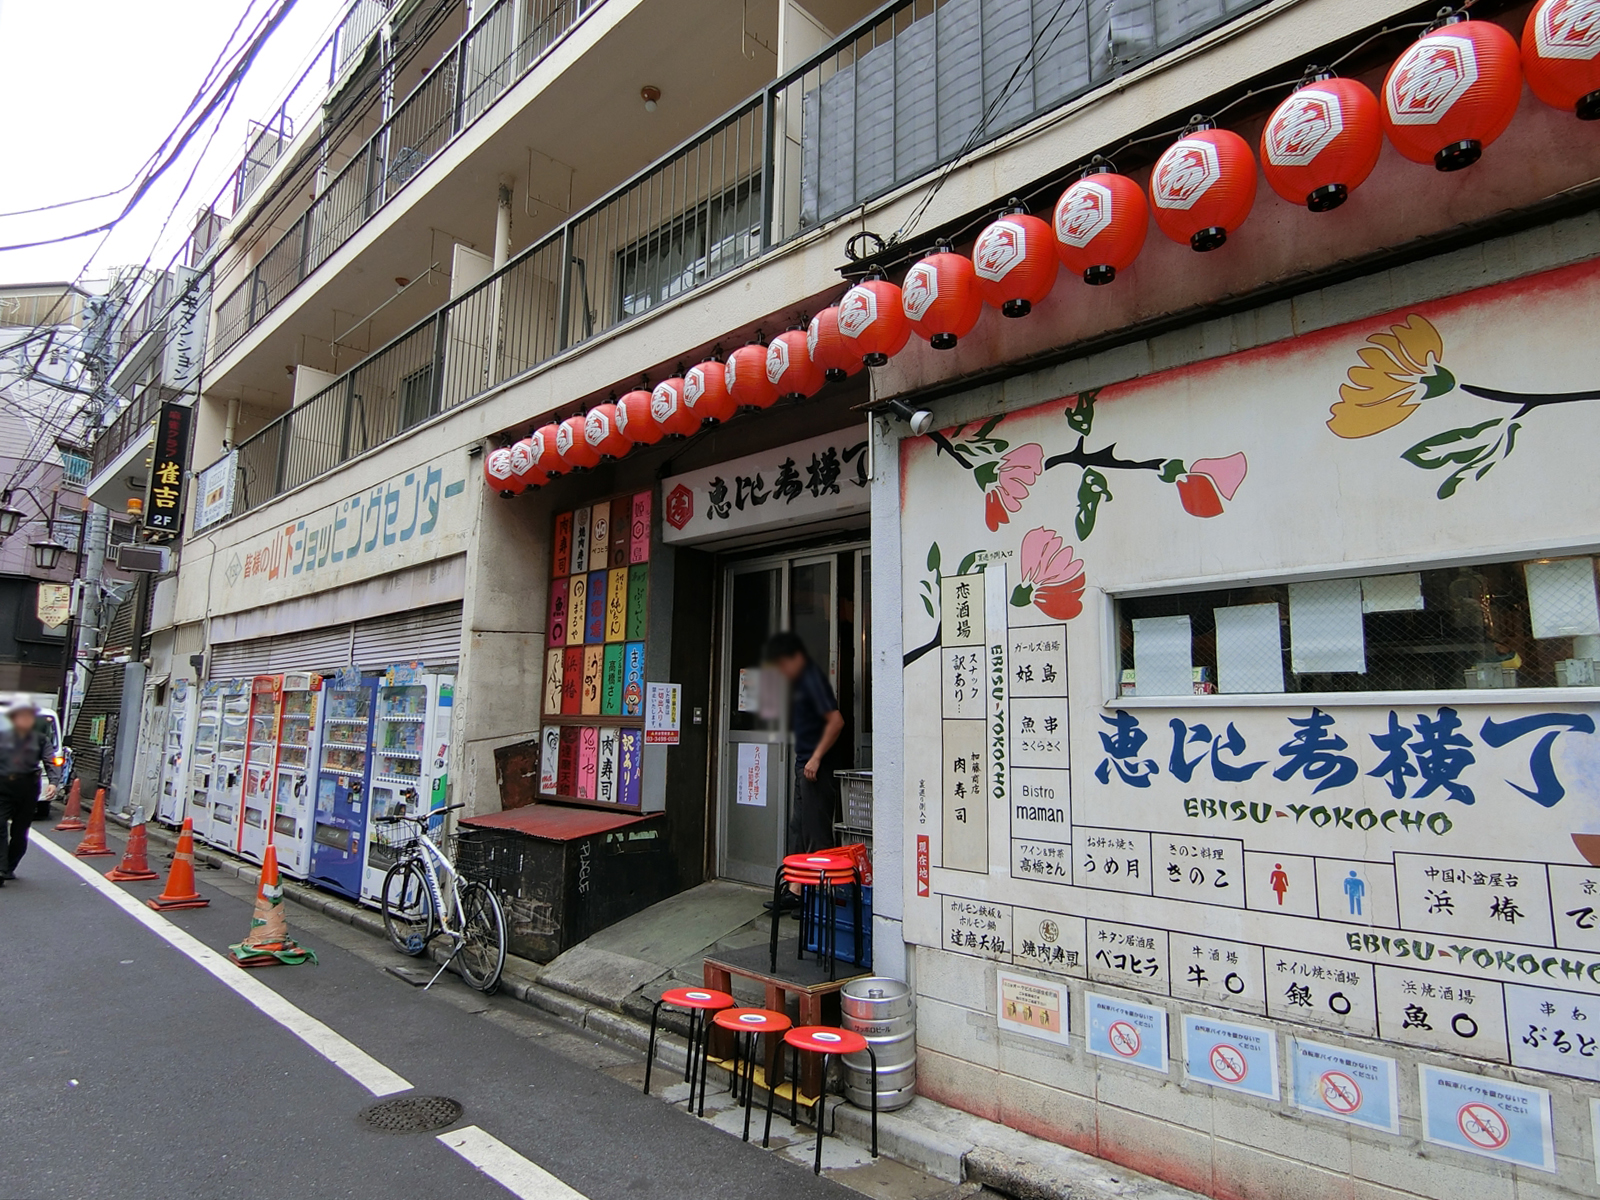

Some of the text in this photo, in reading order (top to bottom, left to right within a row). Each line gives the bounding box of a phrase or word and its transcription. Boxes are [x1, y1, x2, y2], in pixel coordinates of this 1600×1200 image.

[153, 461, 180, 508] 雀吉
[706, 440, 869, 520] 恵比寿横丁
[153, 514, 172, 526] 2F
[557, 517, 569, 573] 肉寿司
[576, 526, 586, 571] 焼肉寿司
[955, 581, 971, 639] 恋酒場
[1013, 640, 1060, 653] ガールズ酒場
[969, 653, 979, 699] スナック
[1016, 663, 1058, 684] 姫島
[991, 644, 1006, 799] EBISU-YOKOCHO
[1021, 716, 1058, 734] 魚串
[1022, 740, 1061, 752] さくらさく
[1094, 706, 1596, 808] 恵比寿横丁
[600, 735, 614, 801] 肉寿司
[970, 751, 981, 795] 加藤商店
[953, 757, 968, 824] 肉寿司
[1022, 785, 1055, 800] Bistro
[1016, 805, 1064, 823] maman
[1183, 797, 1453, 837] EBISU-YOKOCHO
[1086, 836, 1136, 851] お好み焼き
[1168, 843, 1226, 860] きのこ料理
[917, 841, 929, 880] 現在地
[1083, 854, 1140, 878] うめ月
[1166, 862, 1229, 888] きのこ
[951, 901, 1002, 919] ホルモン鉄板&
[1424, 890, 1525, 924] 浜椿
[959, 916, 997, 931] ホルモン鍋
[951, 929, 1005, 954] 達磨天狗
[1021, 939, 1079, 966] 焼肉寿司
[1097, 930, 1155, 950] 牛タン居酒屋
[1095, 951, 1159, 978] ベコヒラ
[1192, 946, 1239, 965] 牛酒場
[1346, 932, 1600, 985] EBISU-YOKOCHO
[1276, 960, 1360, 984] ホイル焼き酒場
[1401, 980, 1475, 1004] 浜焼酒場
[1238, 1042, 1261, 1051] ください
[1522, 1024, 1599, 1057] ぶるど
[1352, 1070, 1378, 1081] ください
[1437, 1079, 1528, 1104] 自転車バイクを置かないで
[1497, 1102, 1528, 1114] ください
